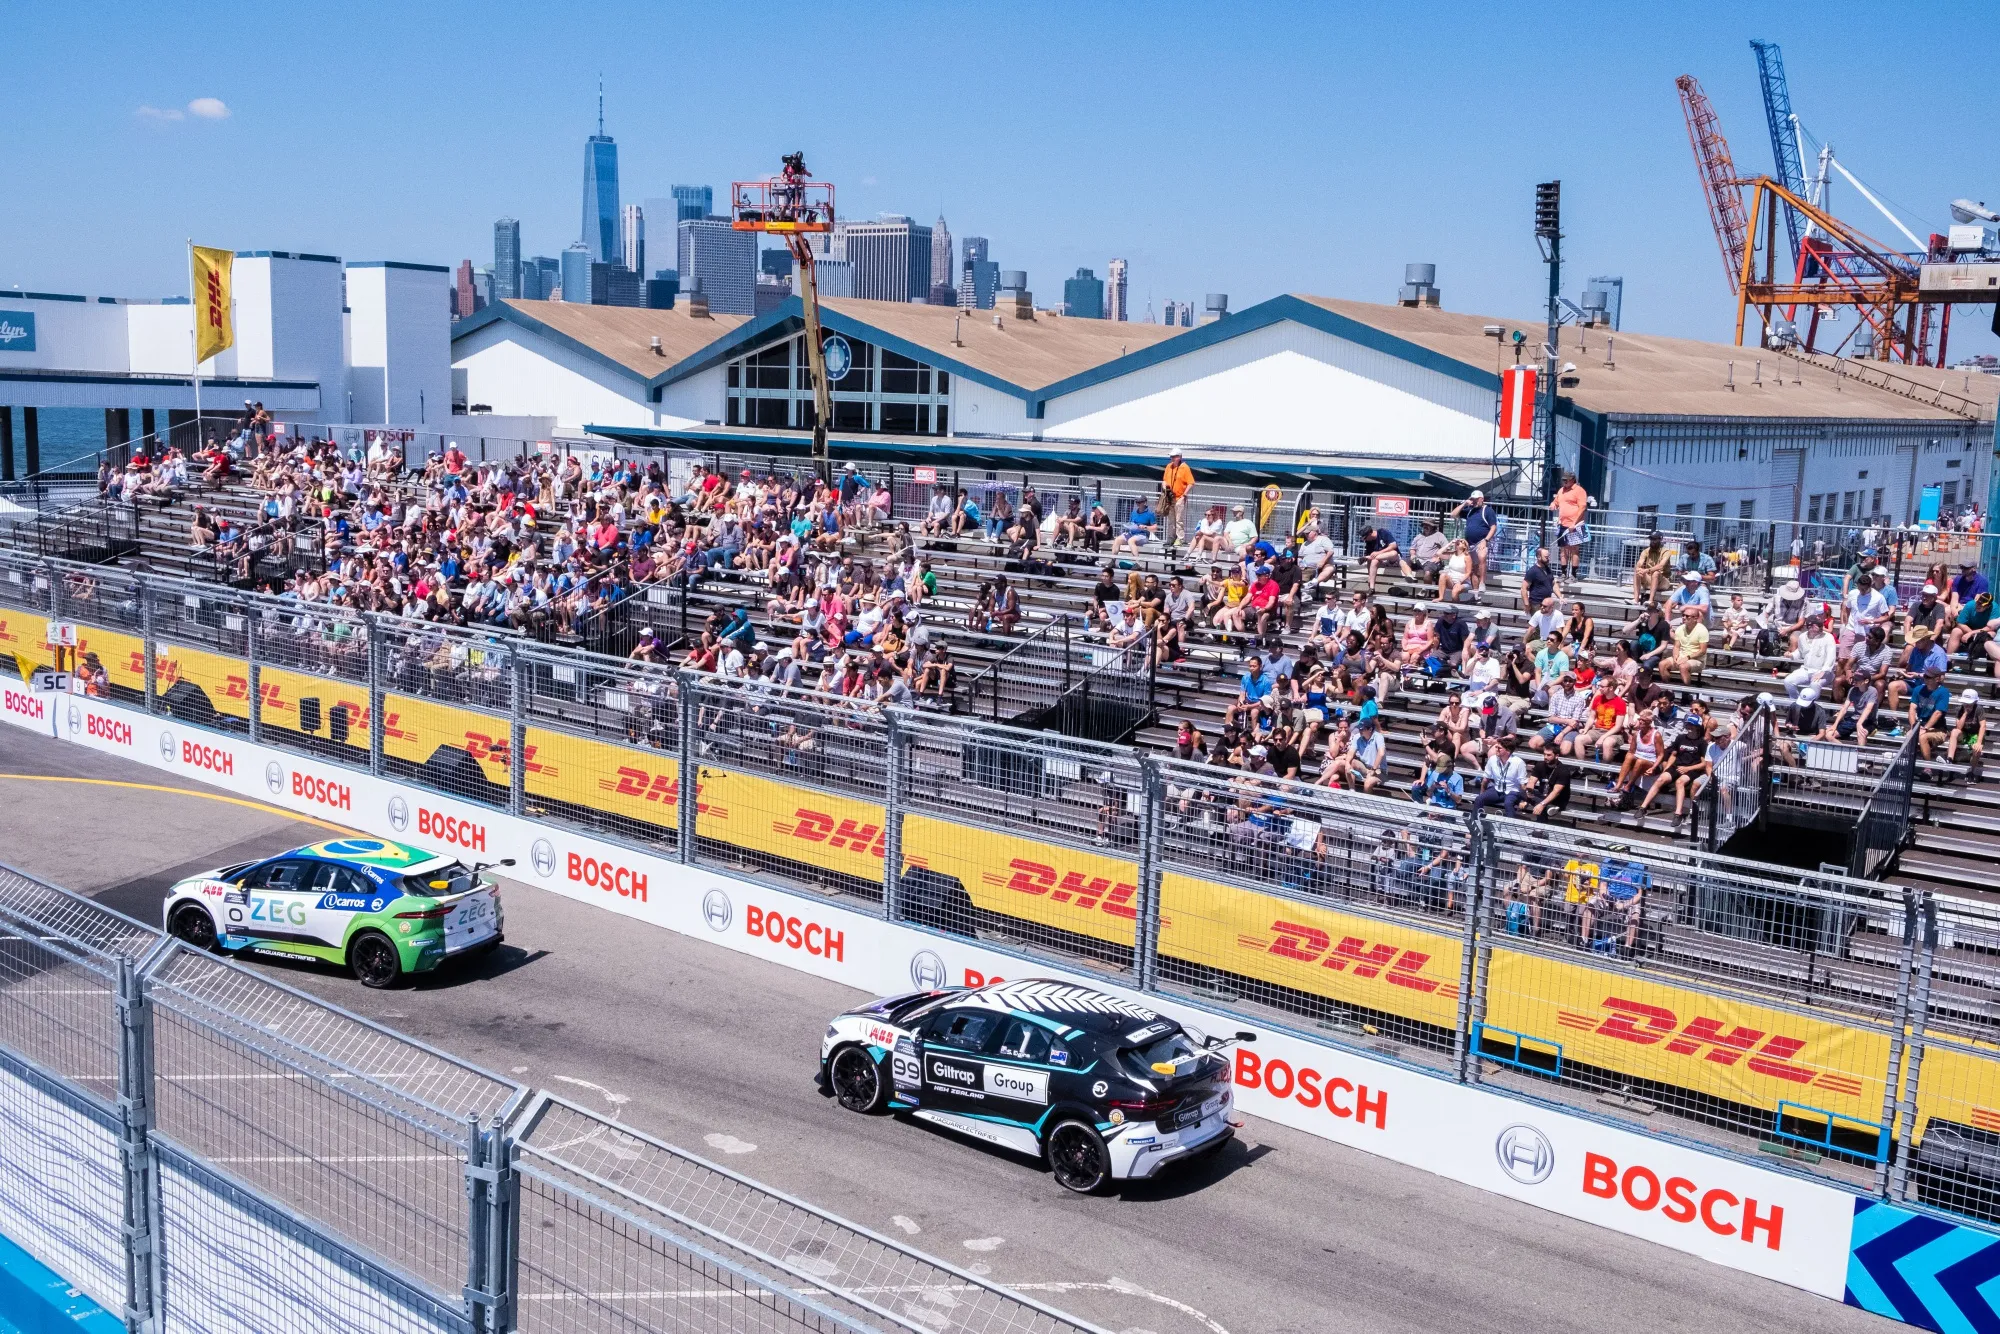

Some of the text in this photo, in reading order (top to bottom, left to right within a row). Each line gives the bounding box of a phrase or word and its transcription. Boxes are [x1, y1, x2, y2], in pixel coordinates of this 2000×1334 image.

[208, 269, 222, 328] DHL
[0, 321, 27, 342] lyn
[367, 428, 414, 441] BOSCH
[44, 675, 66, 690] SC
[5, 691, 43, 719] BOSCH
[88, 714, 131, 745] BOSCH
[183, 741, 232, 775] BOSCH
[293, 772, 350, 810] BOSCH
[419, 808, 485, 852] BOSCH
[203, 886, 223, 896] ABB
[568, 853, 647, 902] BOSCH
[1006, 858, 1137, 920] DHL
[251, 897, 306, 925] ZEG
[459, 903, 486, 925] ZEG
[747, 905, 844, 962] BOSCH
[1268, 920, 1441, 993] DHL
[869, 1028, 893, 1044] ABB
[1596, 997, 1819, 1084] DHL
[894, 1058, 920, 1080] 99
[934, 1062, 1034, 1096] Giltrap Group
[934, 1085, 985, 1099] NEW ZEALAND
[1235, 1048, 1387, 1130] BOSCH
[1179, 1110, 1198, 1122] Giltrap
[1583, 1152, 1784, 1251] BOSCH
